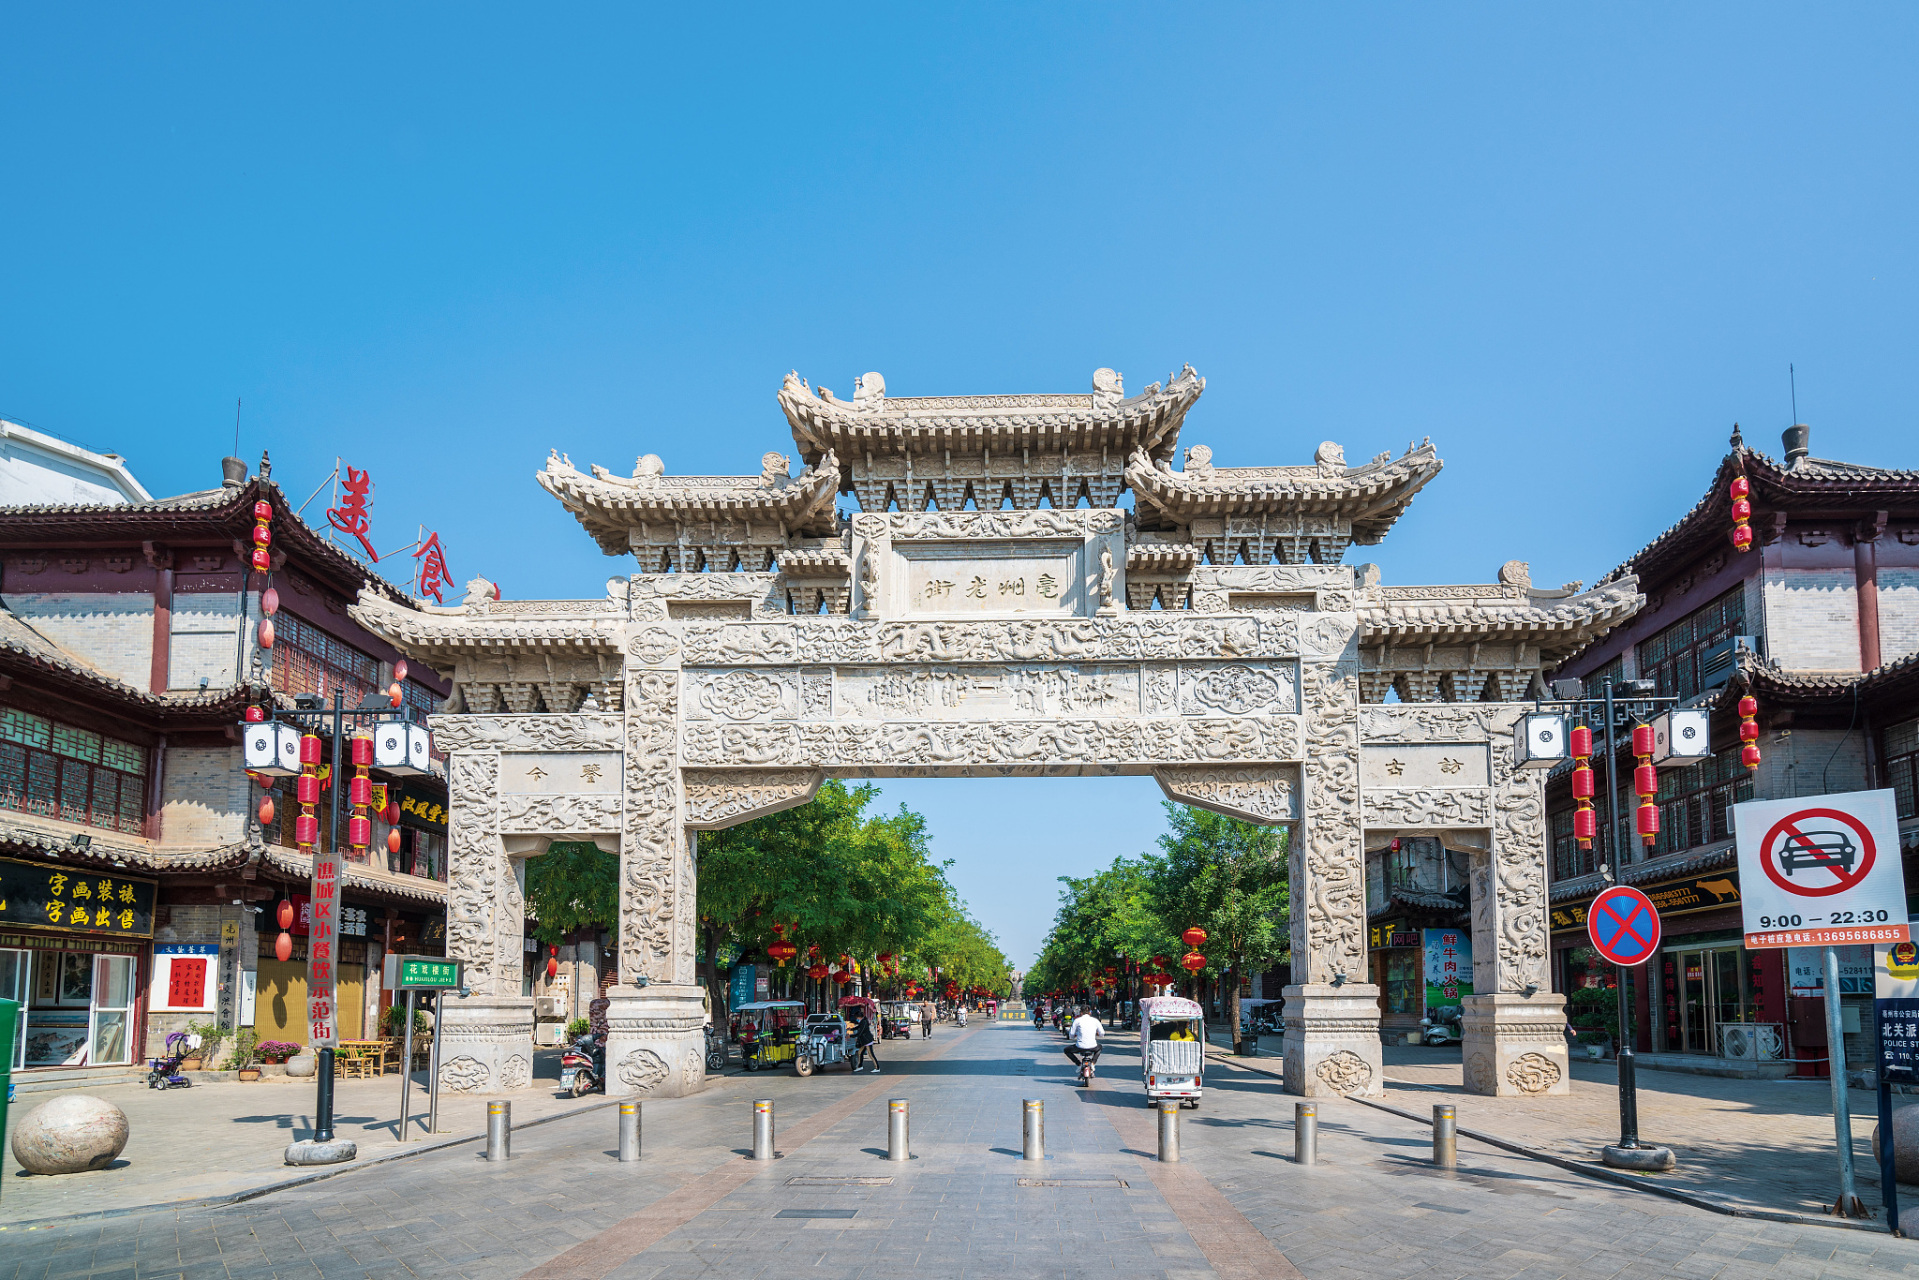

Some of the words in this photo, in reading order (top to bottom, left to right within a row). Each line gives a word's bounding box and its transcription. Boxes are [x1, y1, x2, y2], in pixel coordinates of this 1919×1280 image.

[925, 573, 1058, 599] 亳州老街
[49, 873, 136, 904] 字画装裱
[45, 899, 135, 929] 字画出售
[1760, 914, 1802, 928] 9:00
[1830, 909, 1889, 925] 22:30
[1393, 933, 1419, 946] 网吧
[312, 862, 336, 1039] 谯城区小餐饮示范街
[1882, 1010, 1919, 1018] 亳州市公安局
[1882, 1023, 1917, 1037] 北关派
[1884, 1040, 1907, 1048] POLICE
